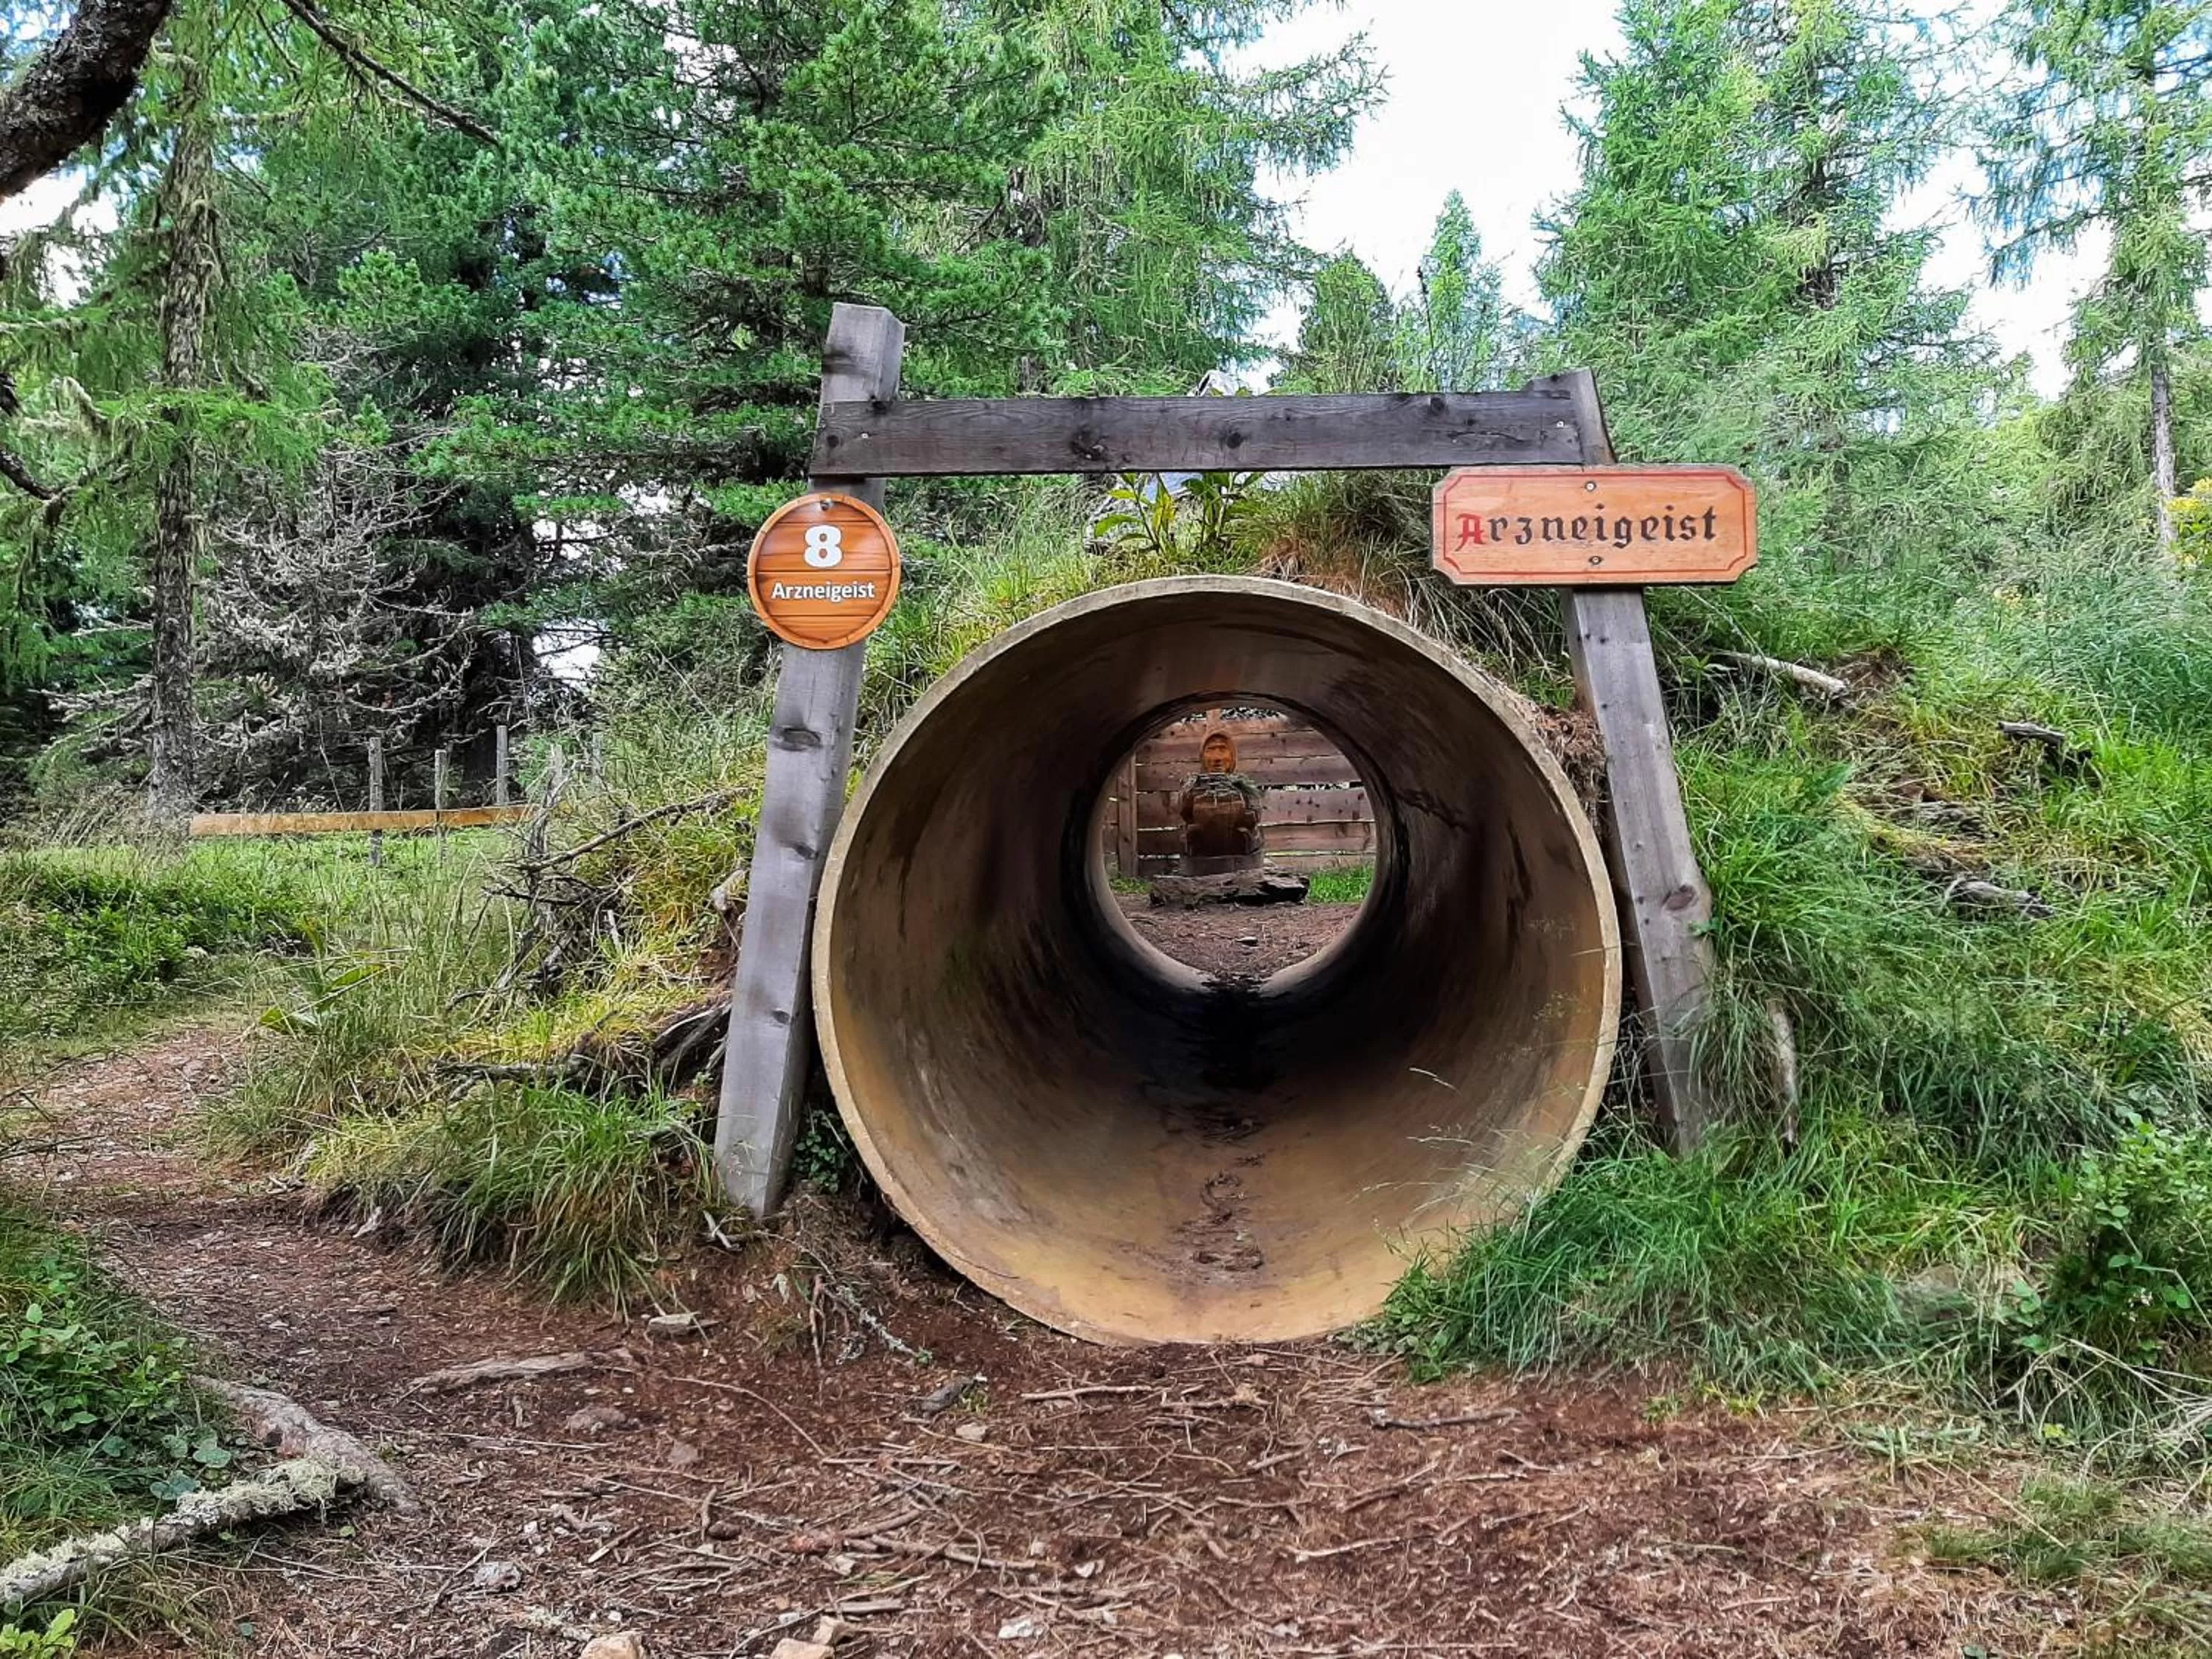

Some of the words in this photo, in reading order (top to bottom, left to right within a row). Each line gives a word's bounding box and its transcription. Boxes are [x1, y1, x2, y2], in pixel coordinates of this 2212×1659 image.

[804, 524, 842, 567] 8
[1455, 504, 1717, 552] Arzneigeist
[771, 581, 874, 602] Arzneigeist
